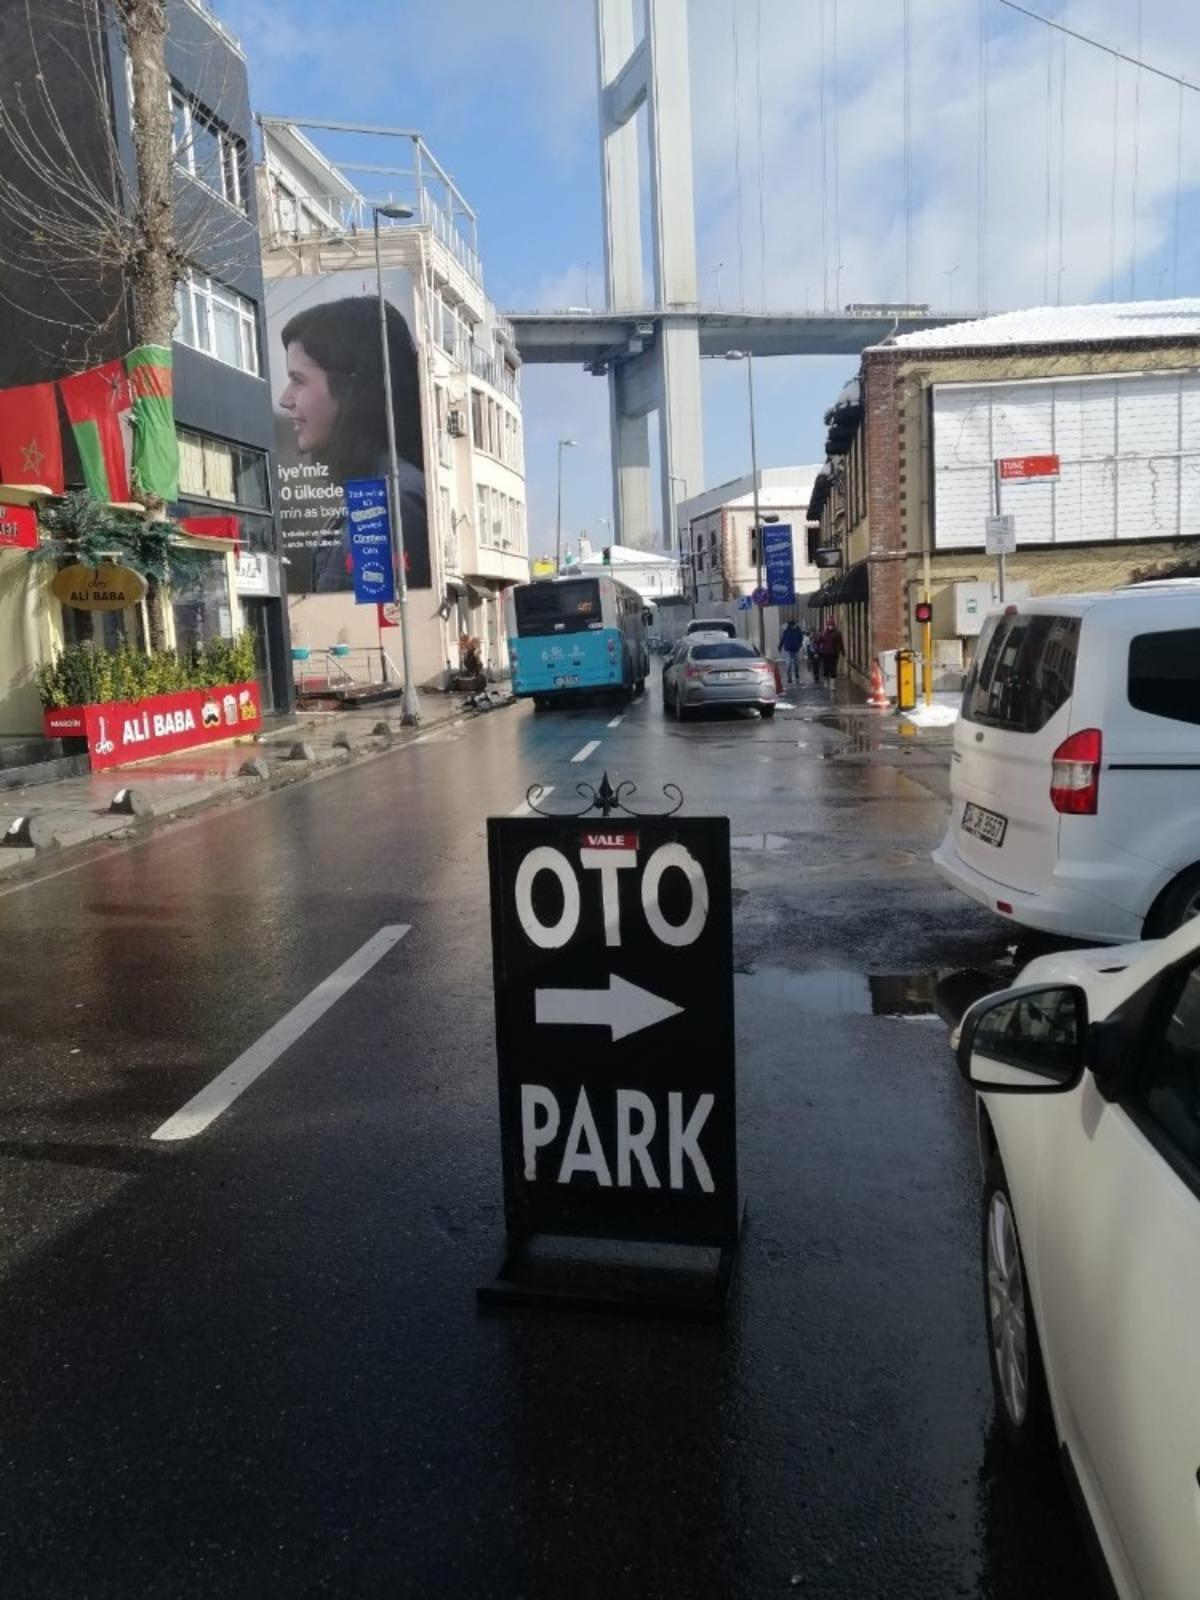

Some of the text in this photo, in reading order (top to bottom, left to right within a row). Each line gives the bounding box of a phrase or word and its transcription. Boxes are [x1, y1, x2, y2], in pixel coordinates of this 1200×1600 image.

[295, 483, 344, 500] ülkede
[304, 508, 318, 518] as
[93, 591, 125, 601] BABA
[122, 708, 195, 745] ALİ BABA
[588, 835, 625, 846] VALE
[514, 842, 709, 949] OTO
[520, 1083, 716, 1193] PARK
